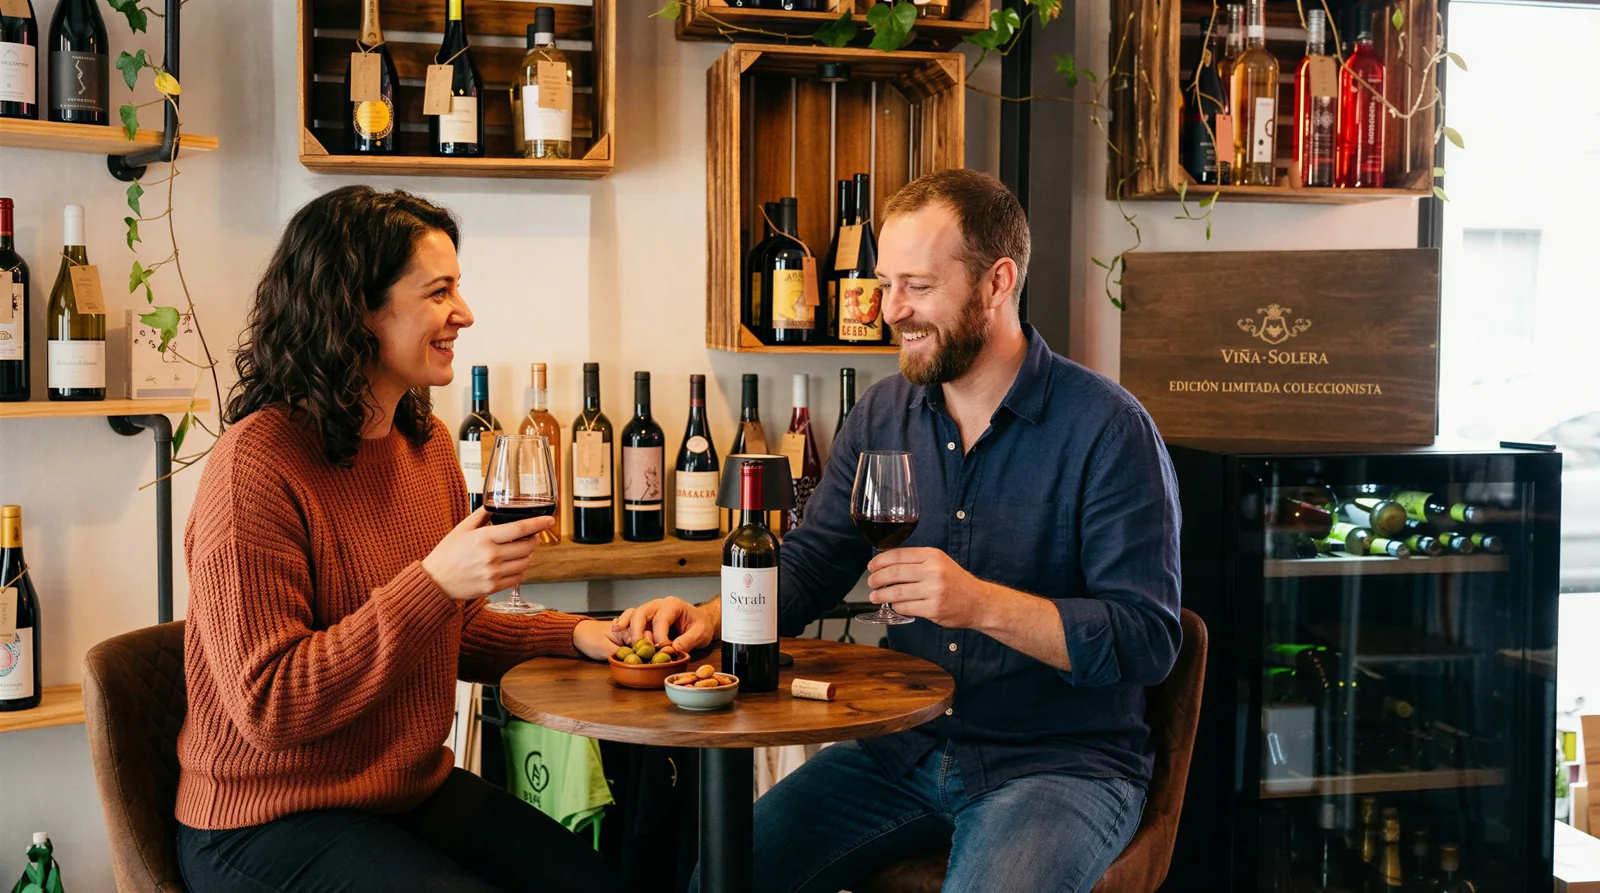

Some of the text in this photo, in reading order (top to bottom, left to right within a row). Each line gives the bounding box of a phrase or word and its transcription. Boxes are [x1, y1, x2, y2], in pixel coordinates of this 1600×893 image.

[1169, 380, 1383, 395] EDICIÓN LIMITADA COLECCIONISTA
